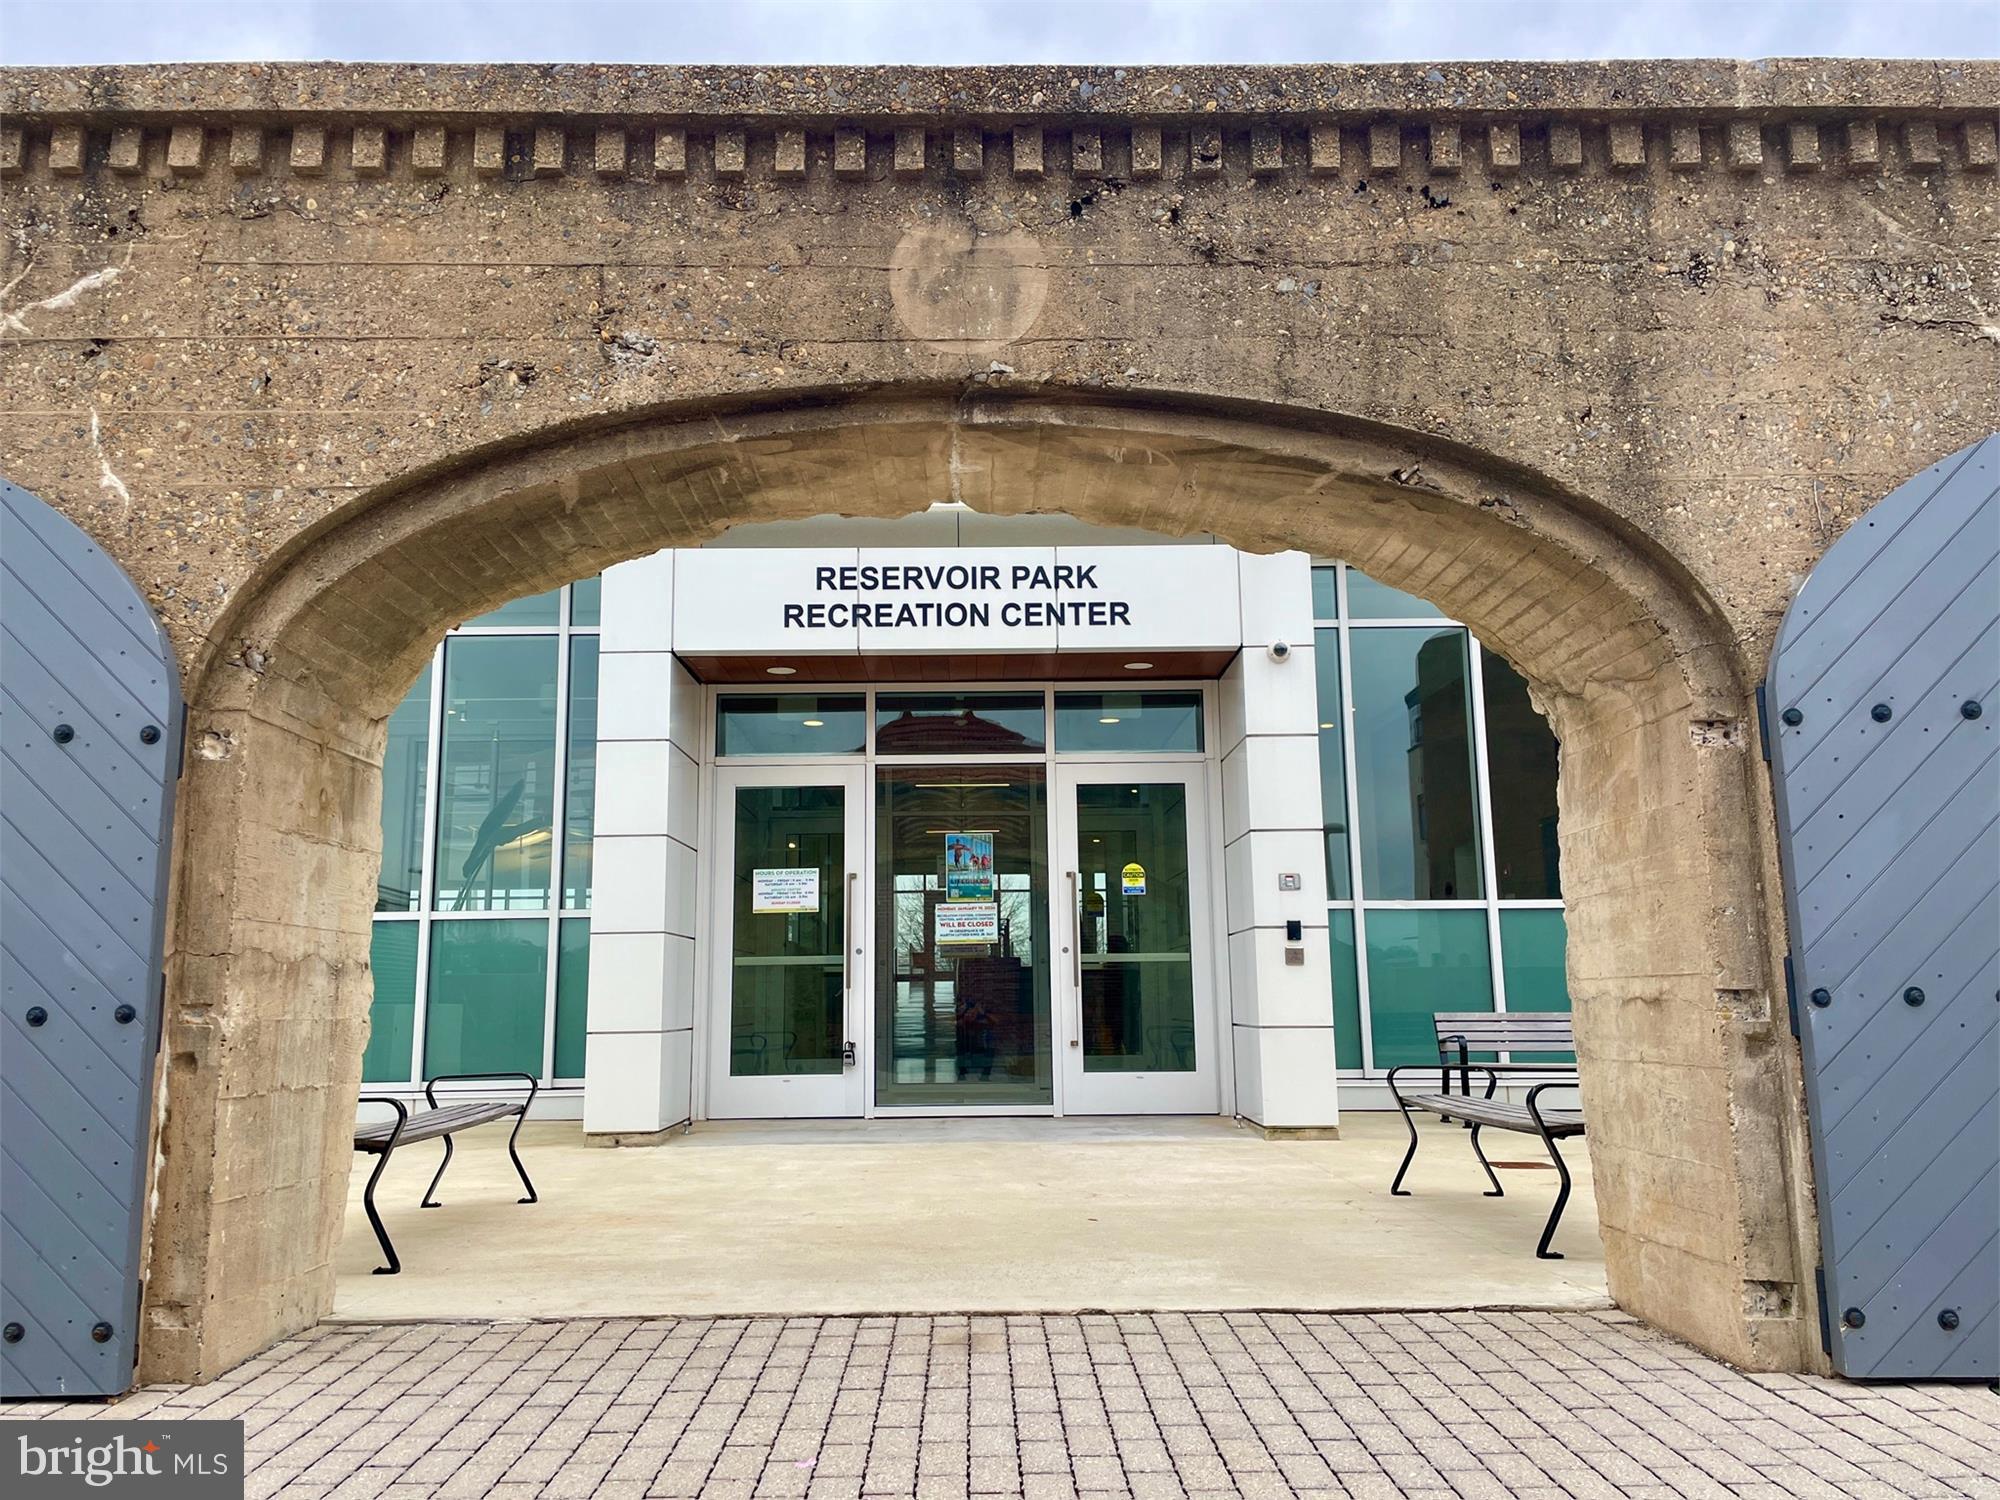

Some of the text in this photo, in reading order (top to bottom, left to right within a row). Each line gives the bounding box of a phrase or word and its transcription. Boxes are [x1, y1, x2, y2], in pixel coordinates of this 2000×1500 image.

[815, 565, 1099, 591] RESERVOIR PARK
[783, 601, 1132, 628] RECREATION CENTER
